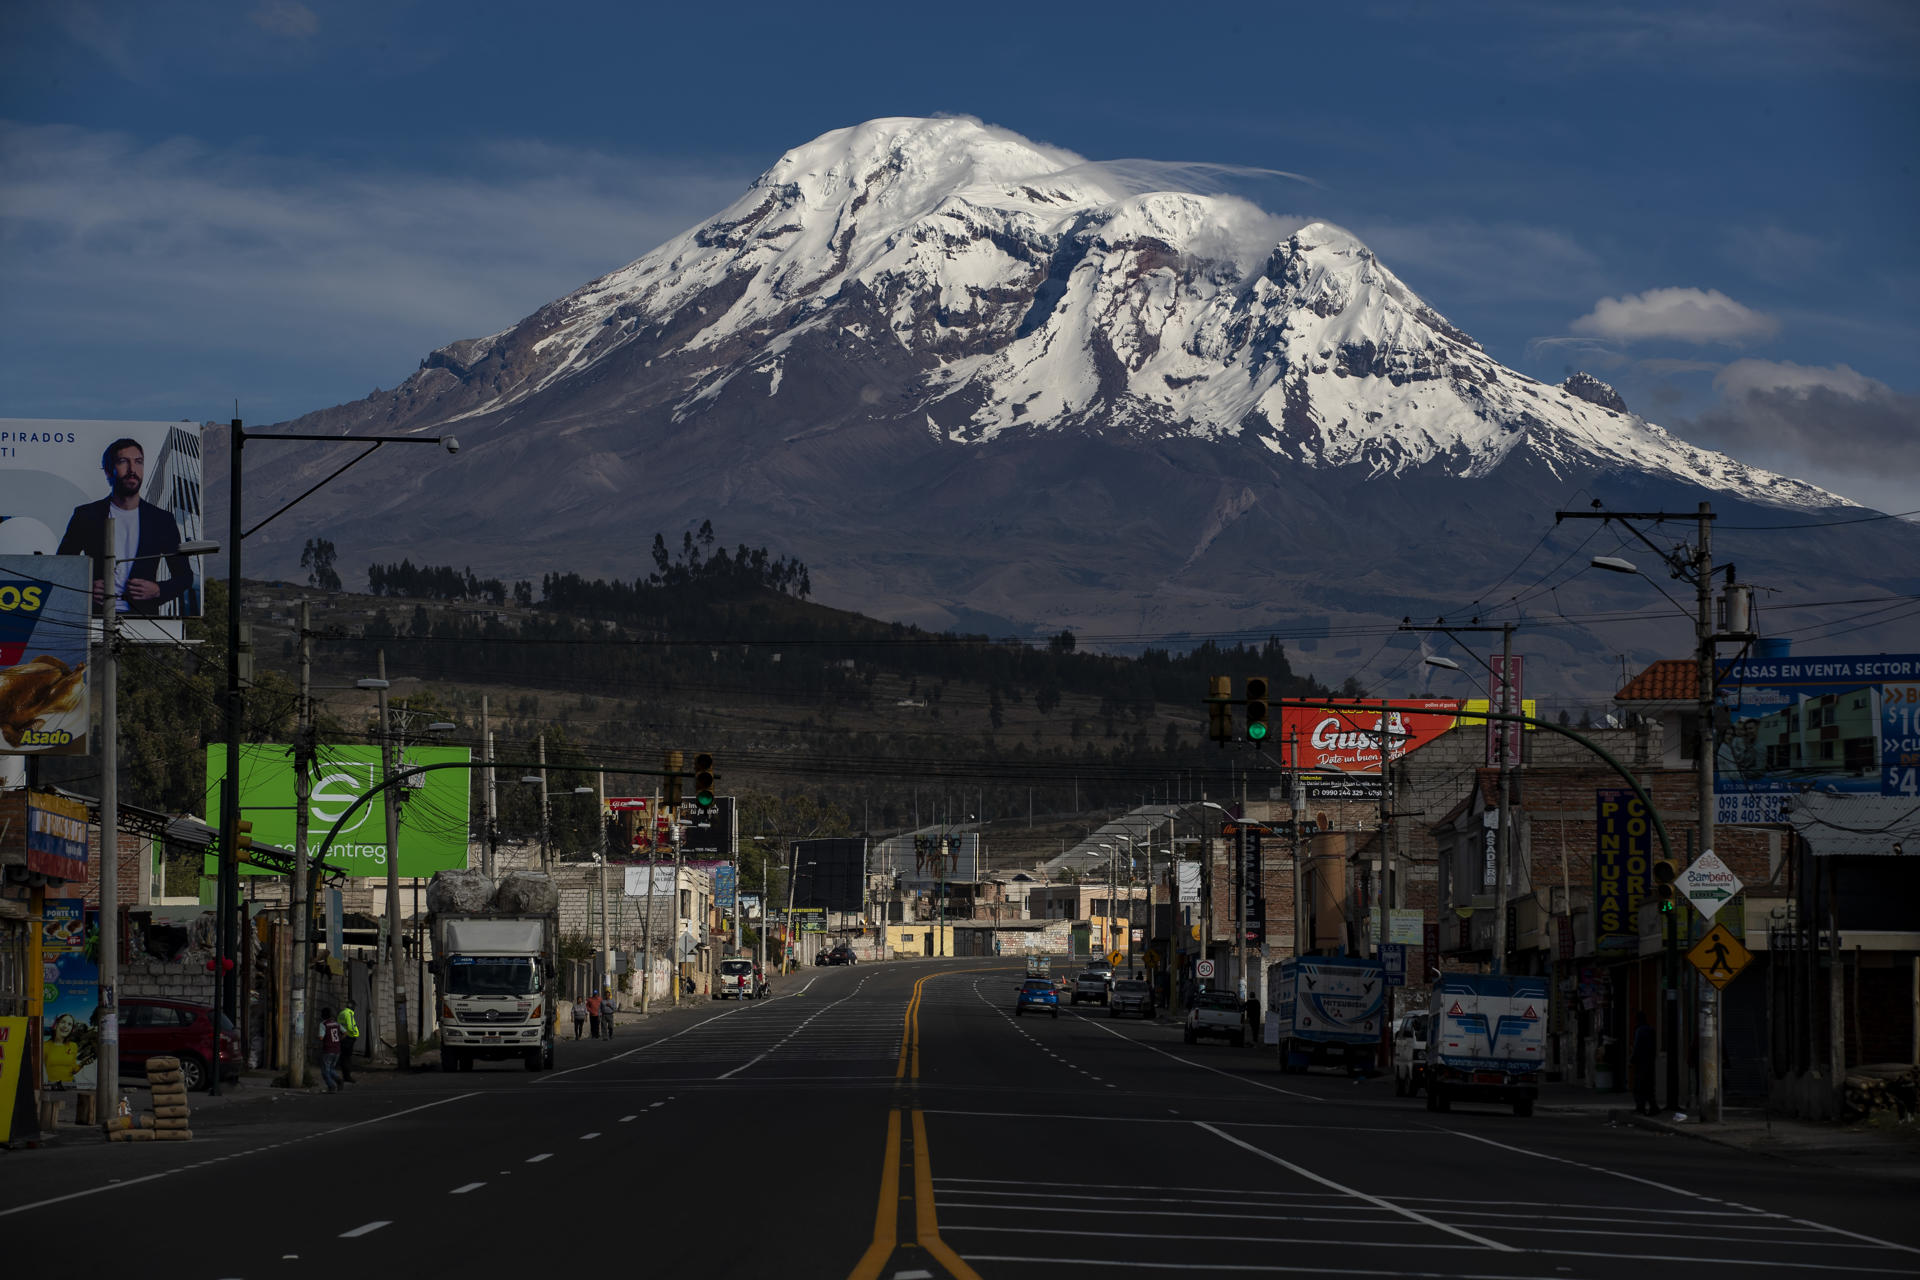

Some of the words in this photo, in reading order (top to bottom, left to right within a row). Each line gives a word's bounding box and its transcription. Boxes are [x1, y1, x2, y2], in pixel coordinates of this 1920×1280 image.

[1, 431, 75, 443] PIRADOS
[0, 447, 16, 457] TI
[0, 585, 43, 611] OS
[1732, 664, 1778, 679] CASAS
[1782, 663, 1801, 677] EN
[1805, 662, 1851, 677] VENTA
[1855, 660, 1912, 676] SECTOR
[20, 729, 71, 745] Asado
[1317, 752, 1343, 765] Date
[1344, 754, 1356, 763] un
[1357, 750, 1379, 762] buen
[1719, 796, 1738, 809] 098
[1718, 810, 1738, 823] 098
[1741, 810, 1760, 823] 405
[1600, 802, 1621, 932] PINTURAS
[1626, 798, 1647, 933] COLORES
[1200, 964, 1211, 973] 50
